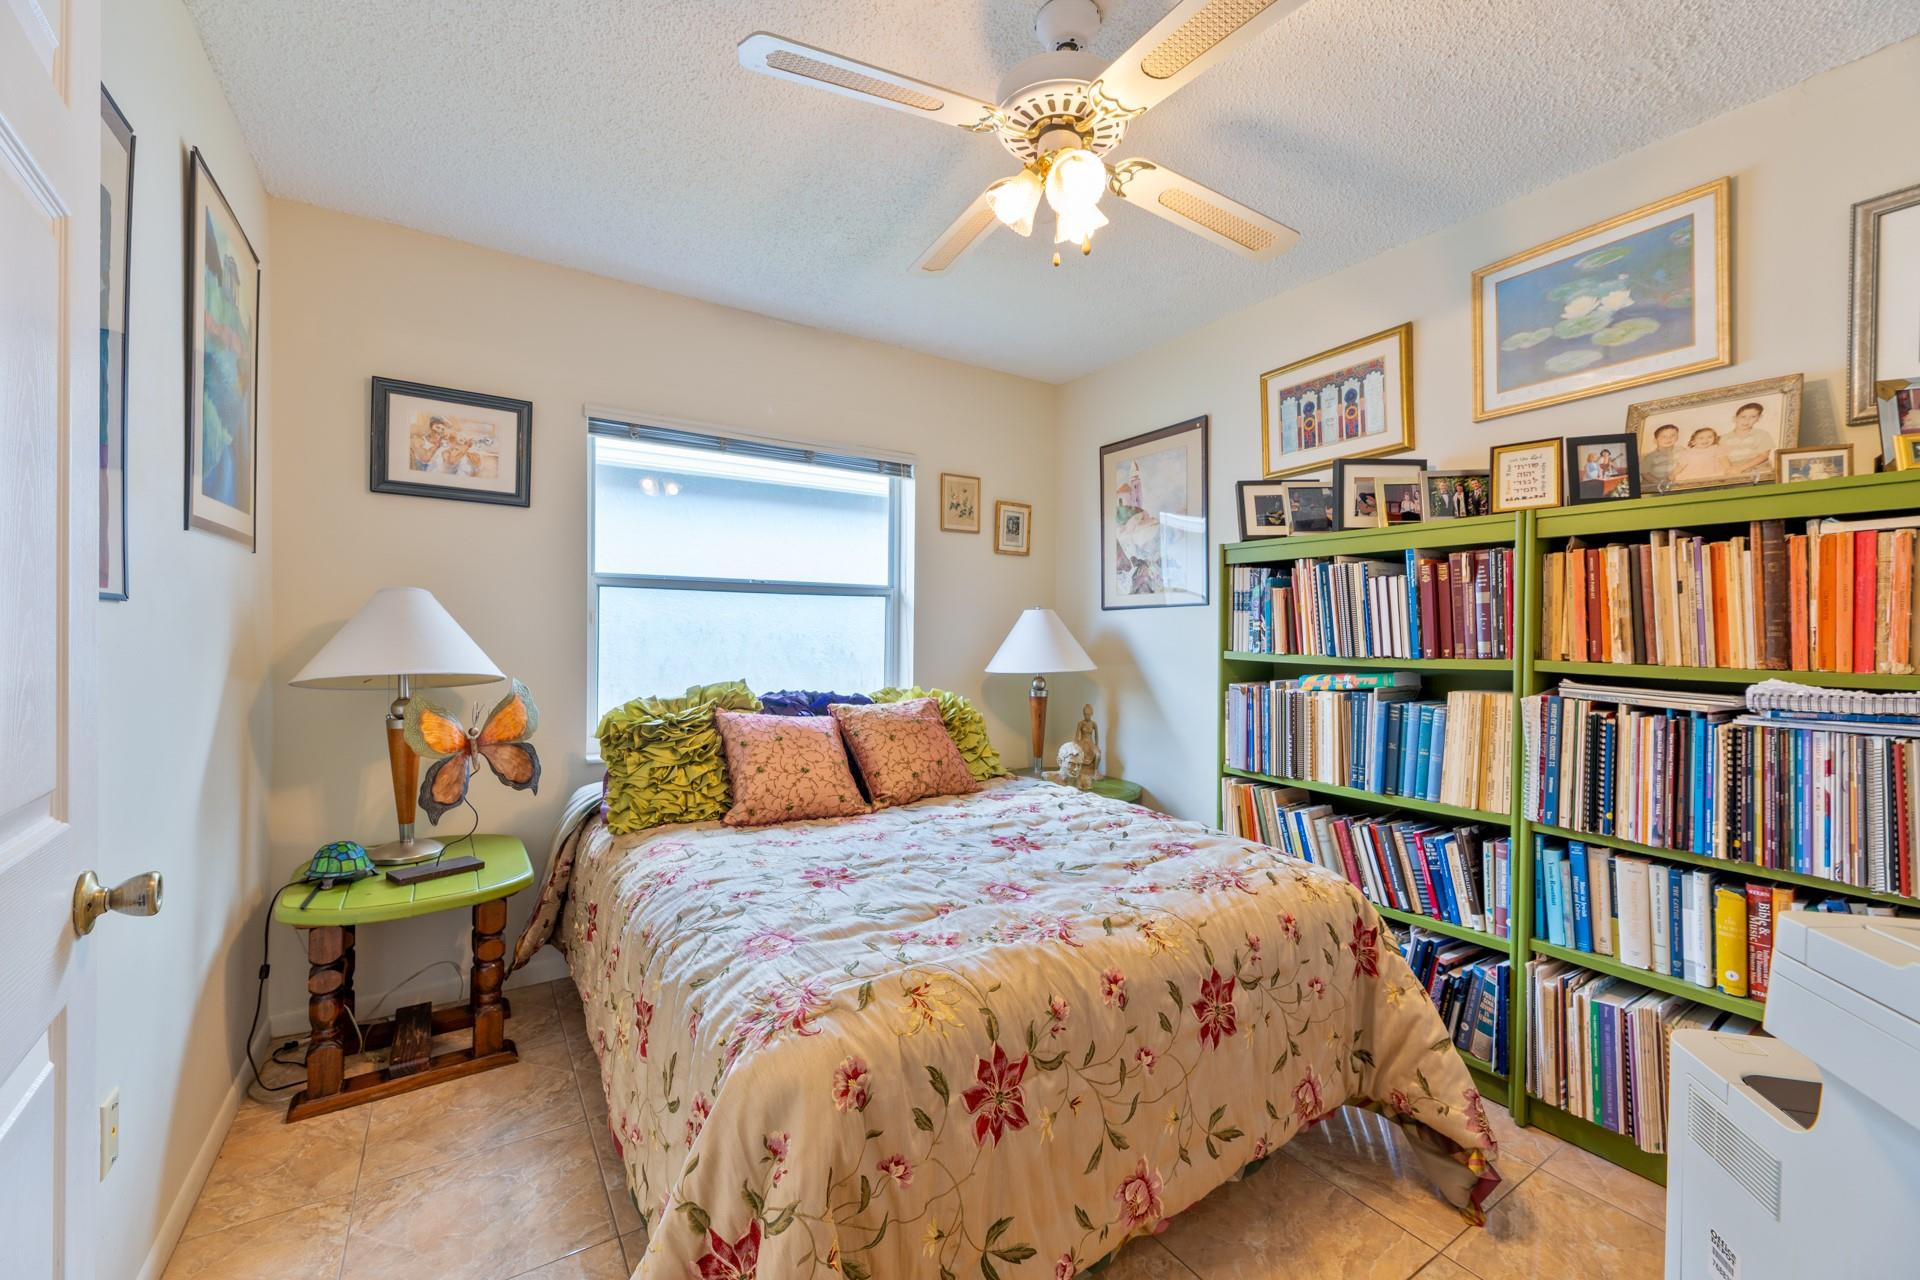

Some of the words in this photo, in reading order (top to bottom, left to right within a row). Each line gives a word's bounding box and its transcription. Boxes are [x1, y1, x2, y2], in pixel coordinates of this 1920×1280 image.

[1758, 902, 1771, 926] Bible
[1749, 914, 1762, 943] Music
[1758, 927, 1770, 935] &
